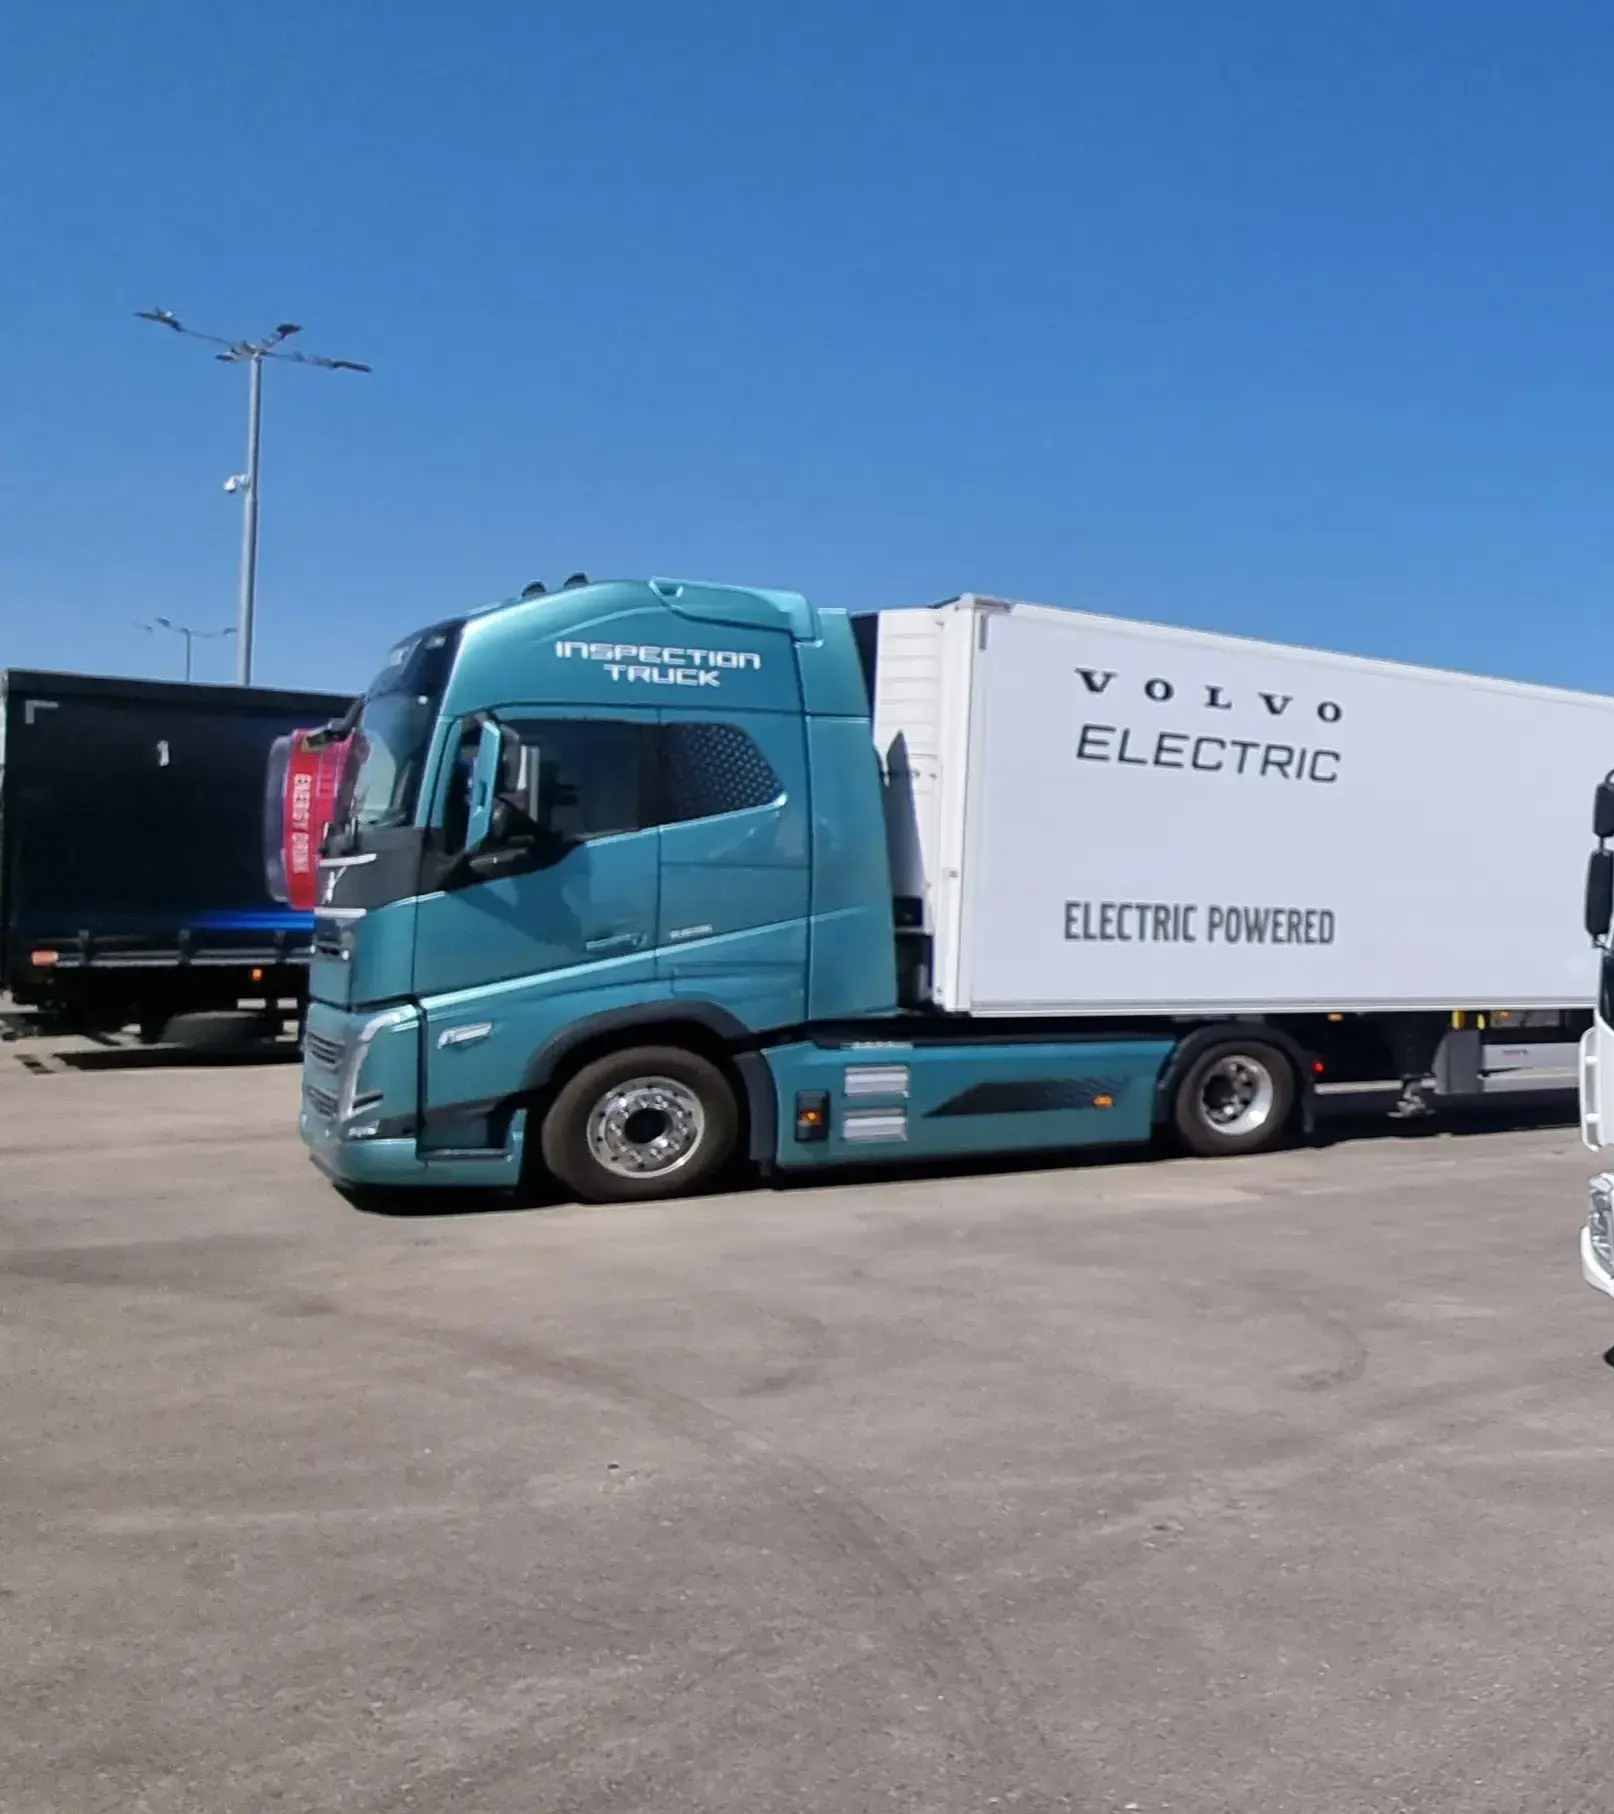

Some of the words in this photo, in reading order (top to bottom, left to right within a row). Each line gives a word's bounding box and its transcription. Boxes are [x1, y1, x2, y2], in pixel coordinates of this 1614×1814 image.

[555, 640, 761, 669] INSPECTION
[604, 663, 720, 687] TRUCK
[1074, 667, 1342, 723] VOLVO
[1076, 723, 1341, 784] ELECTRIC
[1064, 900, 1198, 942] ELECTRIC
[1207, 904, 1335, 944] POWERED
